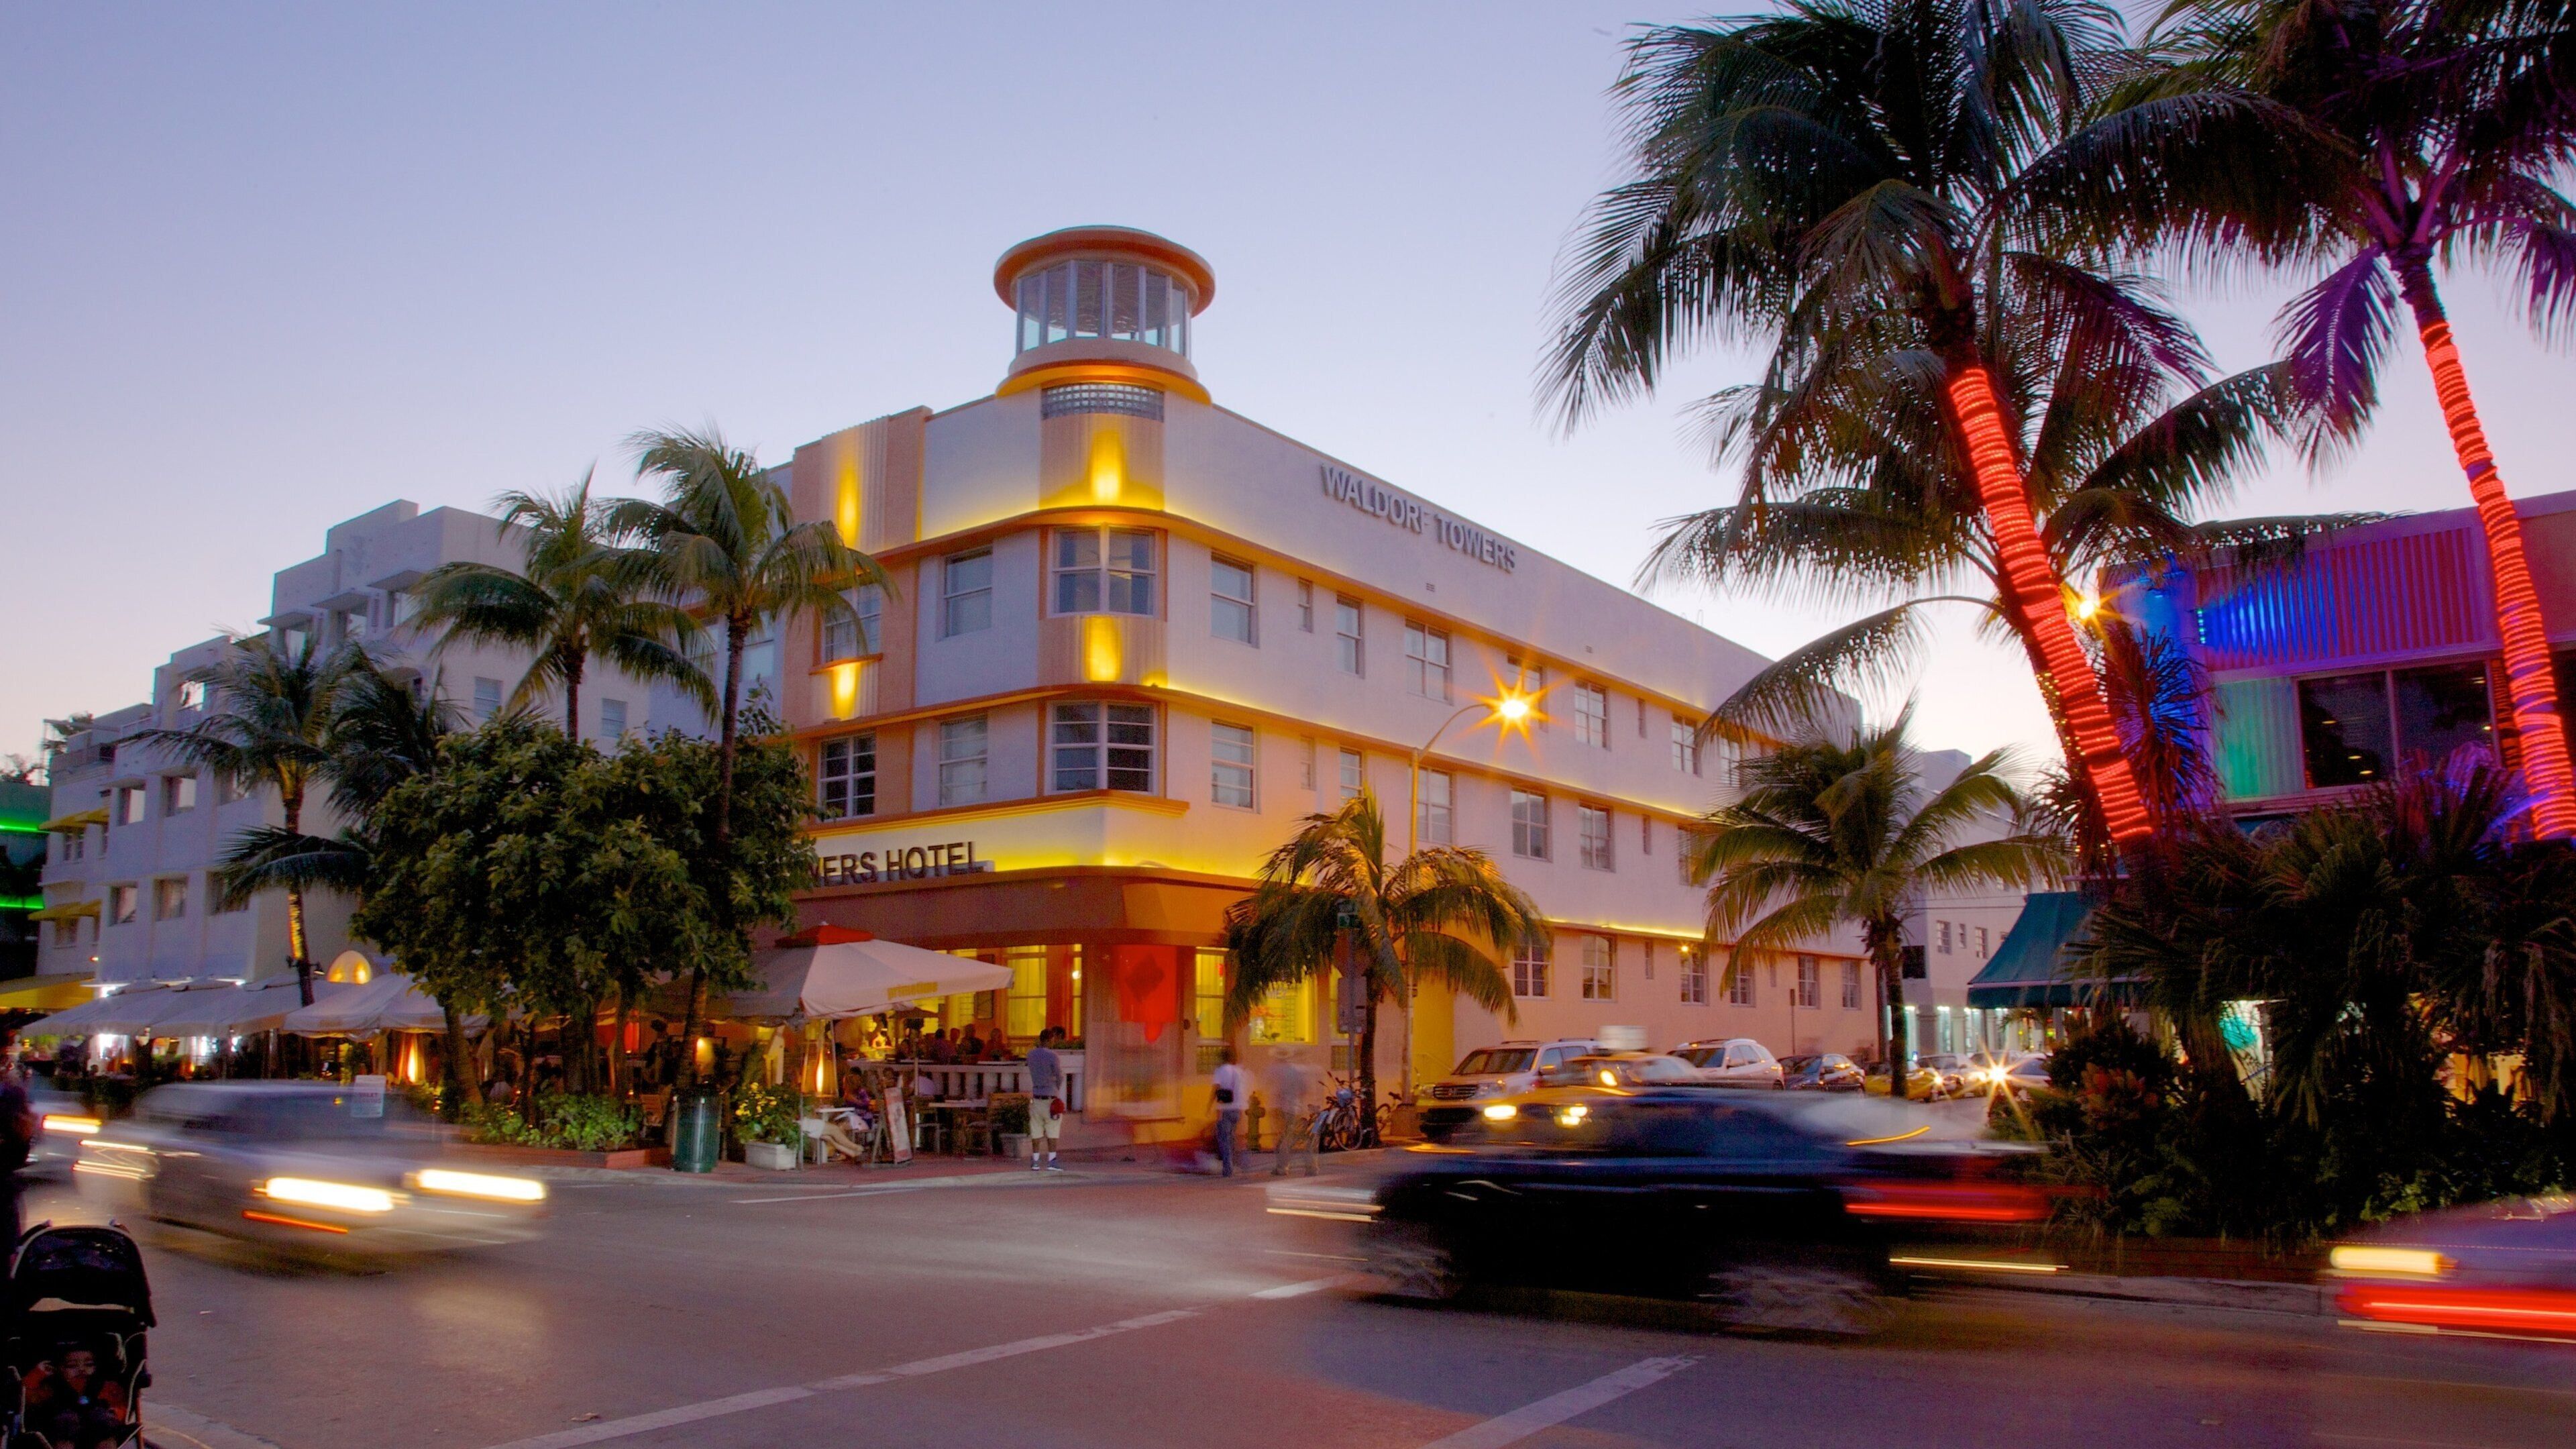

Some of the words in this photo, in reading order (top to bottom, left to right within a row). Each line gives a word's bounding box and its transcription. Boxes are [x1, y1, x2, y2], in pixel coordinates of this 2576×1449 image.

[1321, 464, 1432, 537] WALDORF
[1434, 514, 1517, 573] TOWERS
[885, 841, 983, 881] HOTEL
